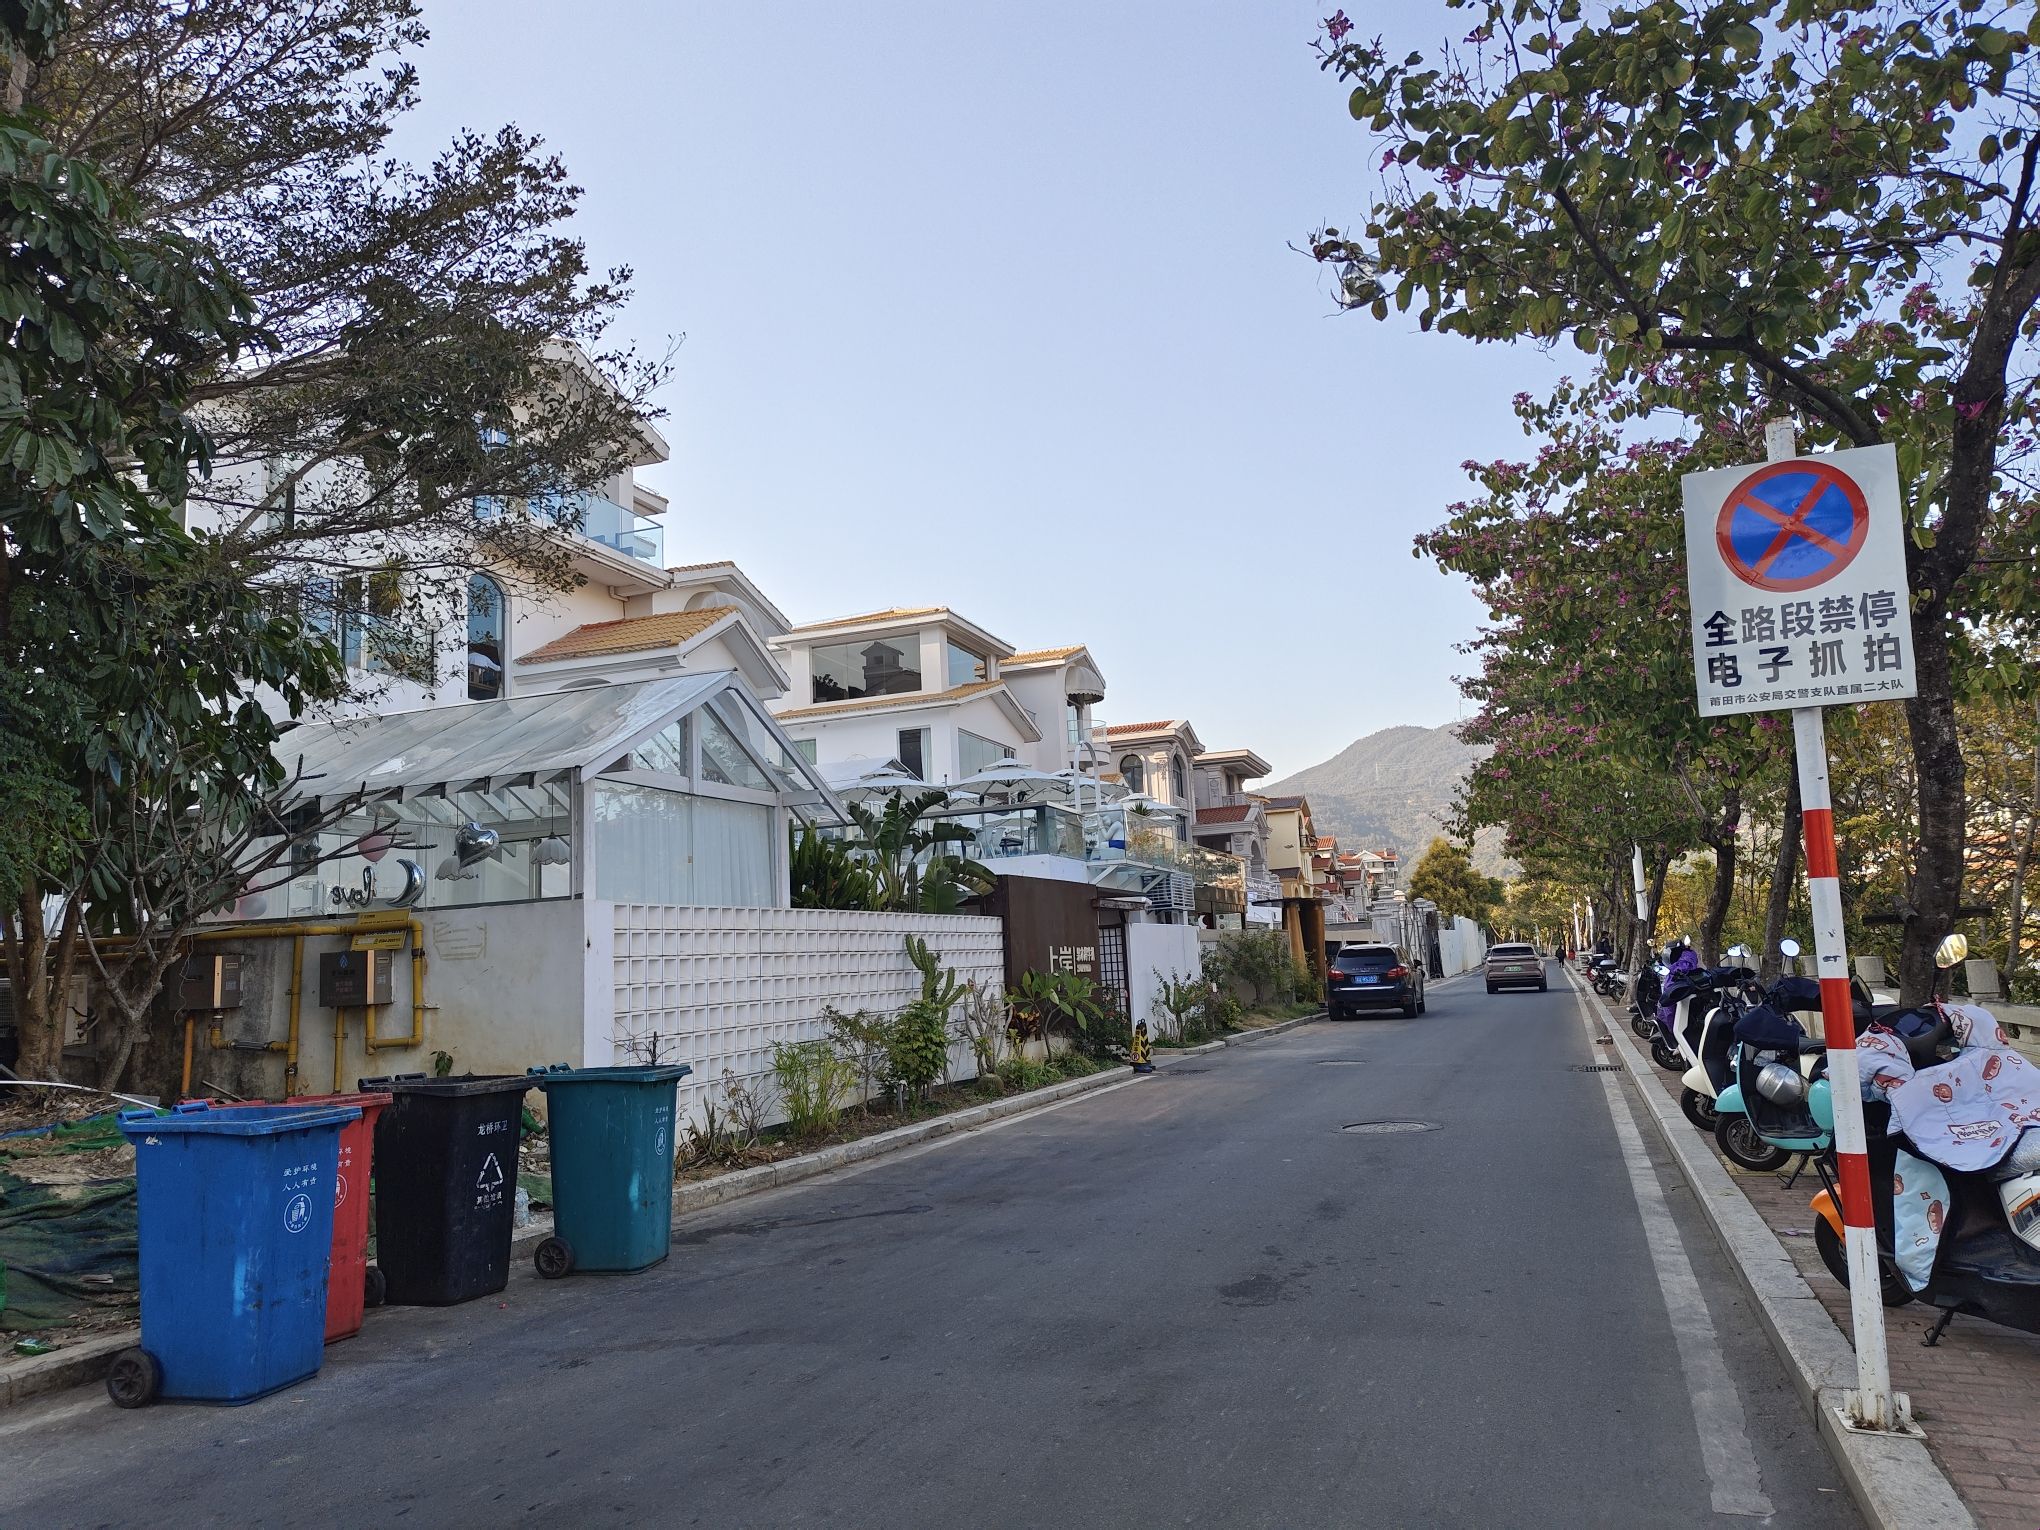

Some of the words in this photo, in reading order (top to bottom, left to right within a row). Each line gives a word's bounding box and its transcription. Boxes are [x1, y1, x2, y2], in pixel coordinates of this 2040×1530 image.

[1703, 590, 1898, 648] 全路段禁停
[1707, 632, 1903, 688] 电子抓拍
[1709, 679, 1904, 707] 莆田市公安局交警支队直属二大队
[282, 1162, 318, 1177] 爱护环境
[281, 1176, 318, 1192] 人人有责
